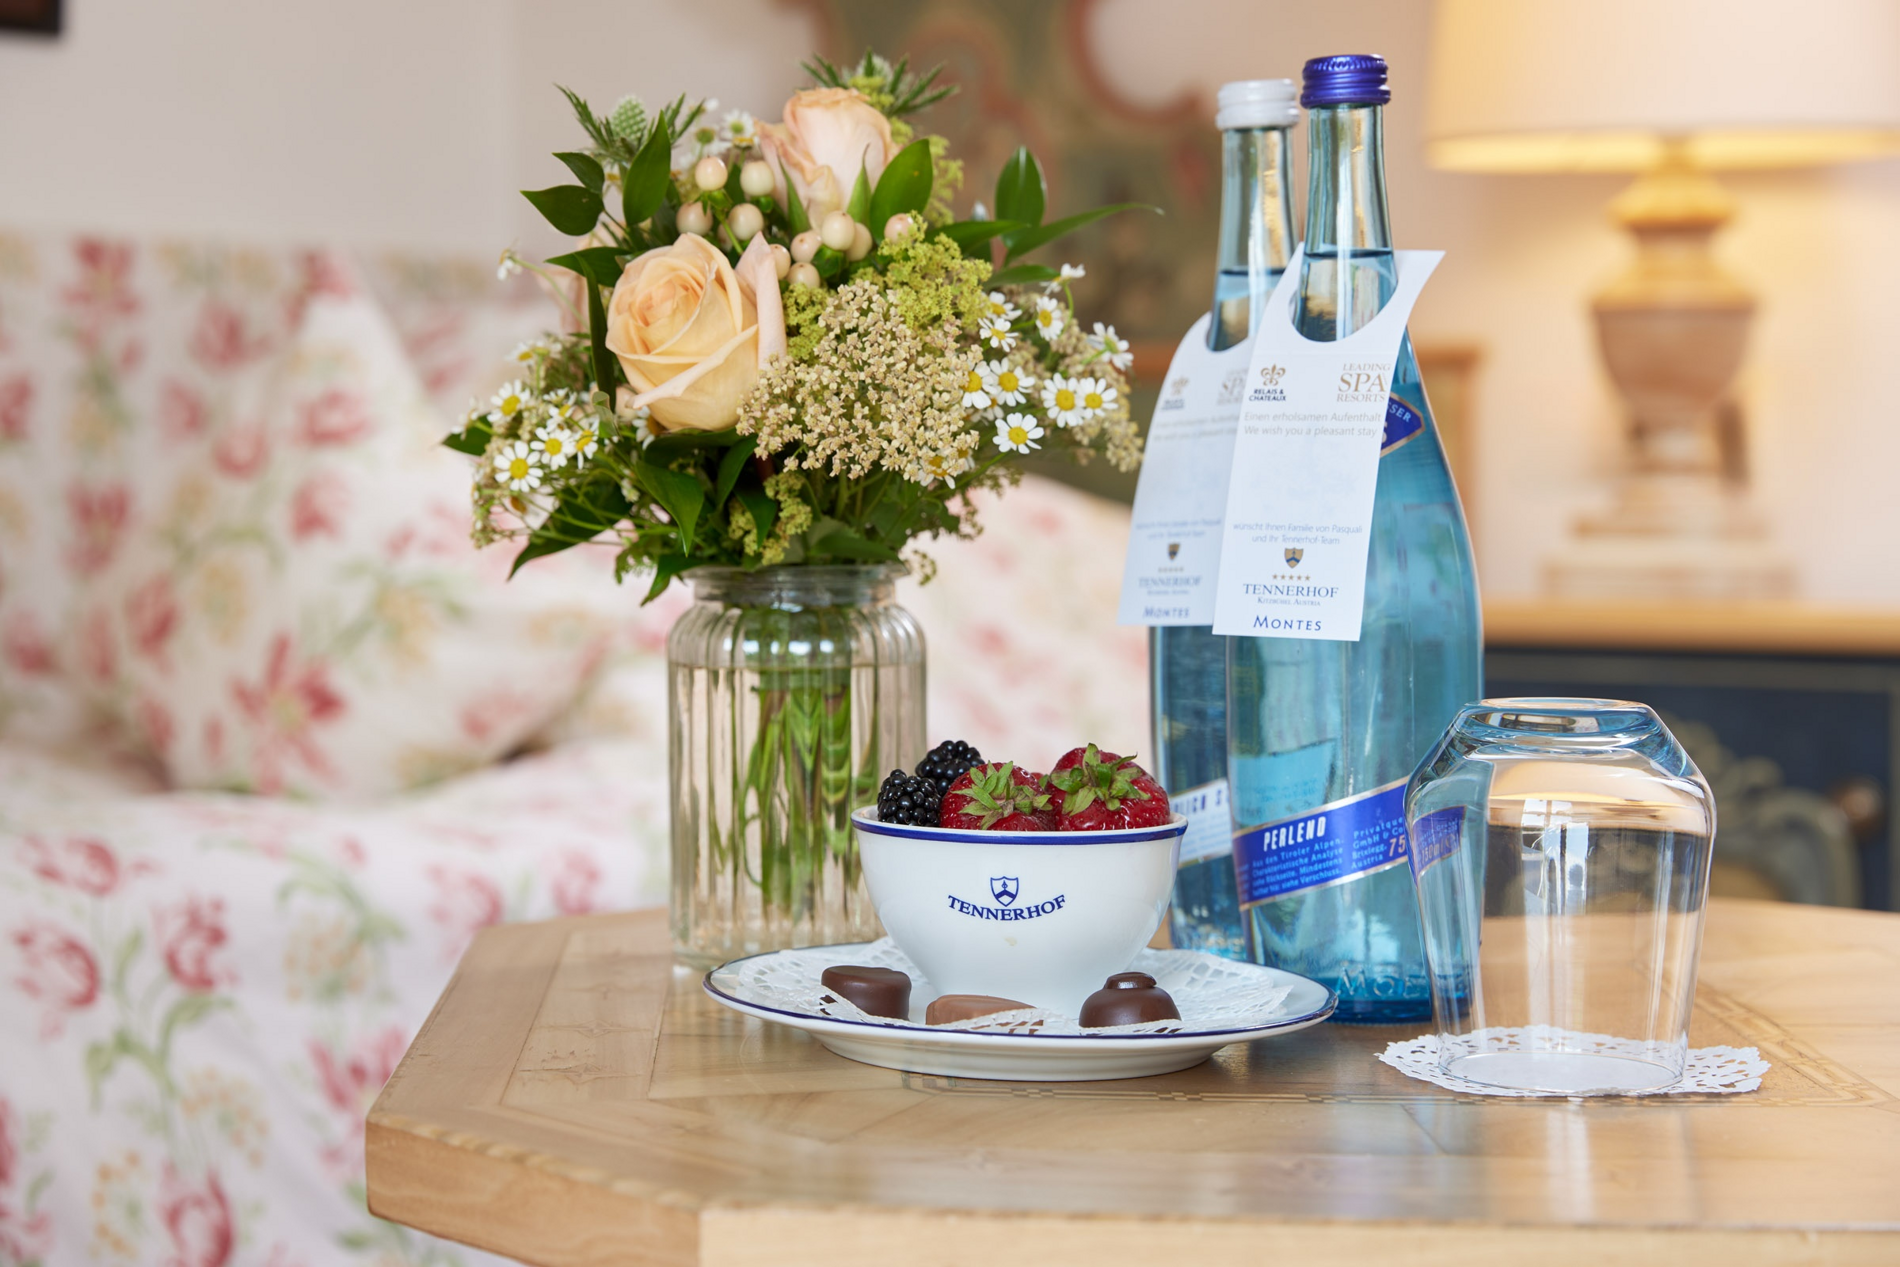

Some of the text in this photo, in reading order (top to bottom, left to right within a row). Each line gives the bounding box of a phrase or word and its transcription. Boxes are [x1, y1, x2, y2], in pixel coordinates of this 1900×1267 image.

[1343, 363, 1391, 372] LEADING
[1338, 372, 1387, 393] SPA
[1336, 393, 1386, 403] RESORTS
[1244, 412, 1270, 422] Einen
[1272, 412, 1328, 422] erholsamen
[1330, 412, 1381, 423] Aufenthalt
[1389, 401, 1412, 423] SER
[1244, 425, 1260, 435] We
[1262, 425, 1283, 436] wish
[1285, 428, 1303, 438] you
[1305, 428, 1312, 436] a
[1314, 426, 1355, 438] pleasant
[1358, 427, 1378, 439] stay
[1265, 523, 1286, 532] Ihnen
[1287, 524, 1314, 533] Familie
[1331, 525, 1363, 535] Pasquali
[1252, 535, 1267, 543] und
[1243, 583, 1339, 598] TENNERHOF
[1263, 816, 1327, 852] PERLEND
[1353, 833, 1379, 849] GmbH
[1281, 847, 1310, 860] Tiroler
[1311, 847, 1343, 862] Analyse
[1351, 853, 1383, 869] Austria
[1299, 858, 1343, 874] Mindestens
[948, 894, 1066, 921] TENNERHOF
